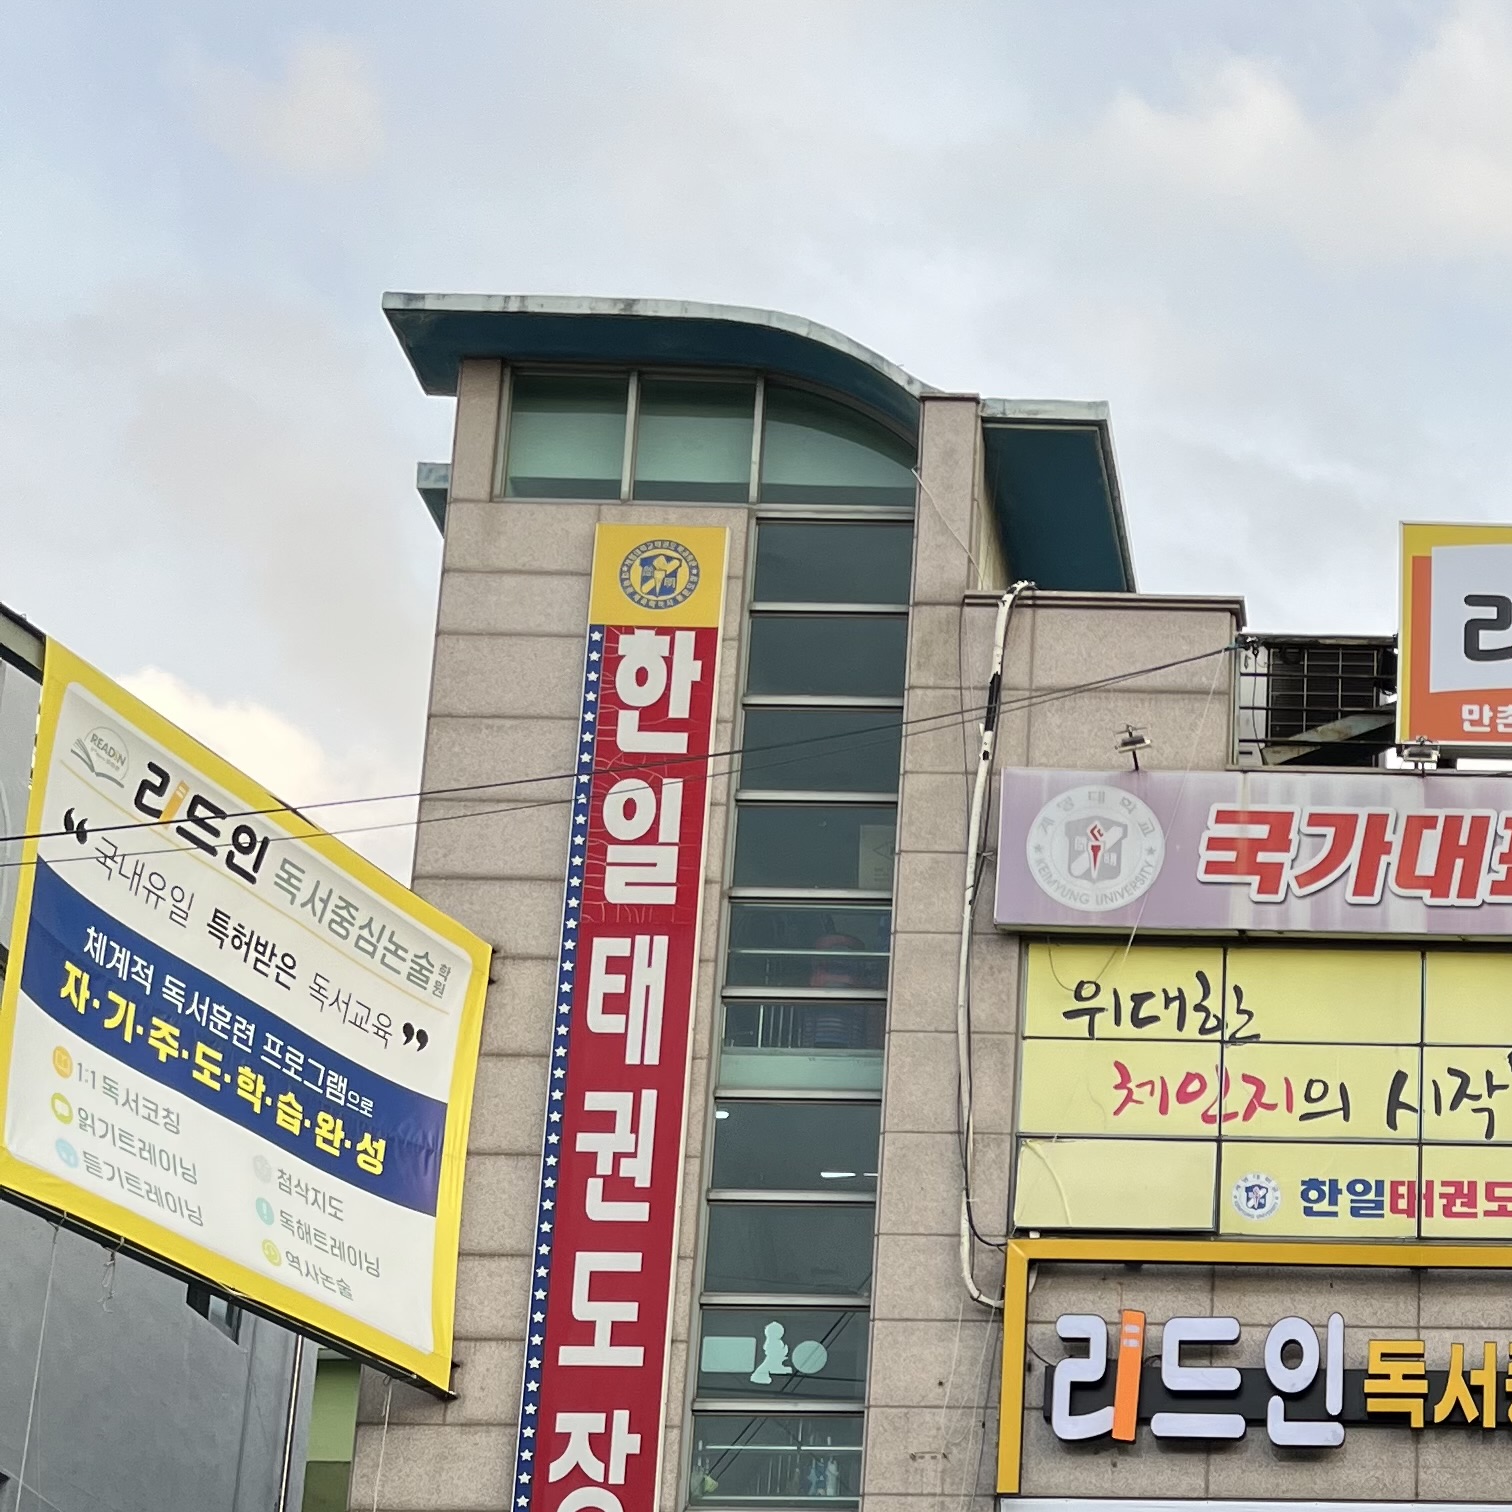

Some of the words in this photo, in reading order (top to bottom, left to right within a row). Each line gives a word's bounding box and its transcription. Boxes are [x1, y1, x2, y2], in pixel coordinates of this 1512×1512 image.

[134, 761, 271, 885] 리드인
[272, 857, 435, 991] 독서중심논술
[206, 908, 297, 990] 특허받은
[84, 926, 155, 995] 체계적
[162, 974, 256, 1054] 독서훈련
[260, 1033, 374, 1118] 프로그램으로
[1063, 971, 1261, 1041] 위대한
[1113, 1061, 1350, 1125] 체인지의
[1386, 1069, 1510, 1140] 시작
[77, 1107, 199, 1185] 읽기트레이닝
[82, 1149, 205, 1228] 듣기트레이닝
[277, 1168, 345, 1222] 첨삭지도
[279, 1208, 381, 1278] 독해트레이닝
[285, 1250, 354, 1301] 역사논술
[1051, 1309, 1346, 1447] 리드인
